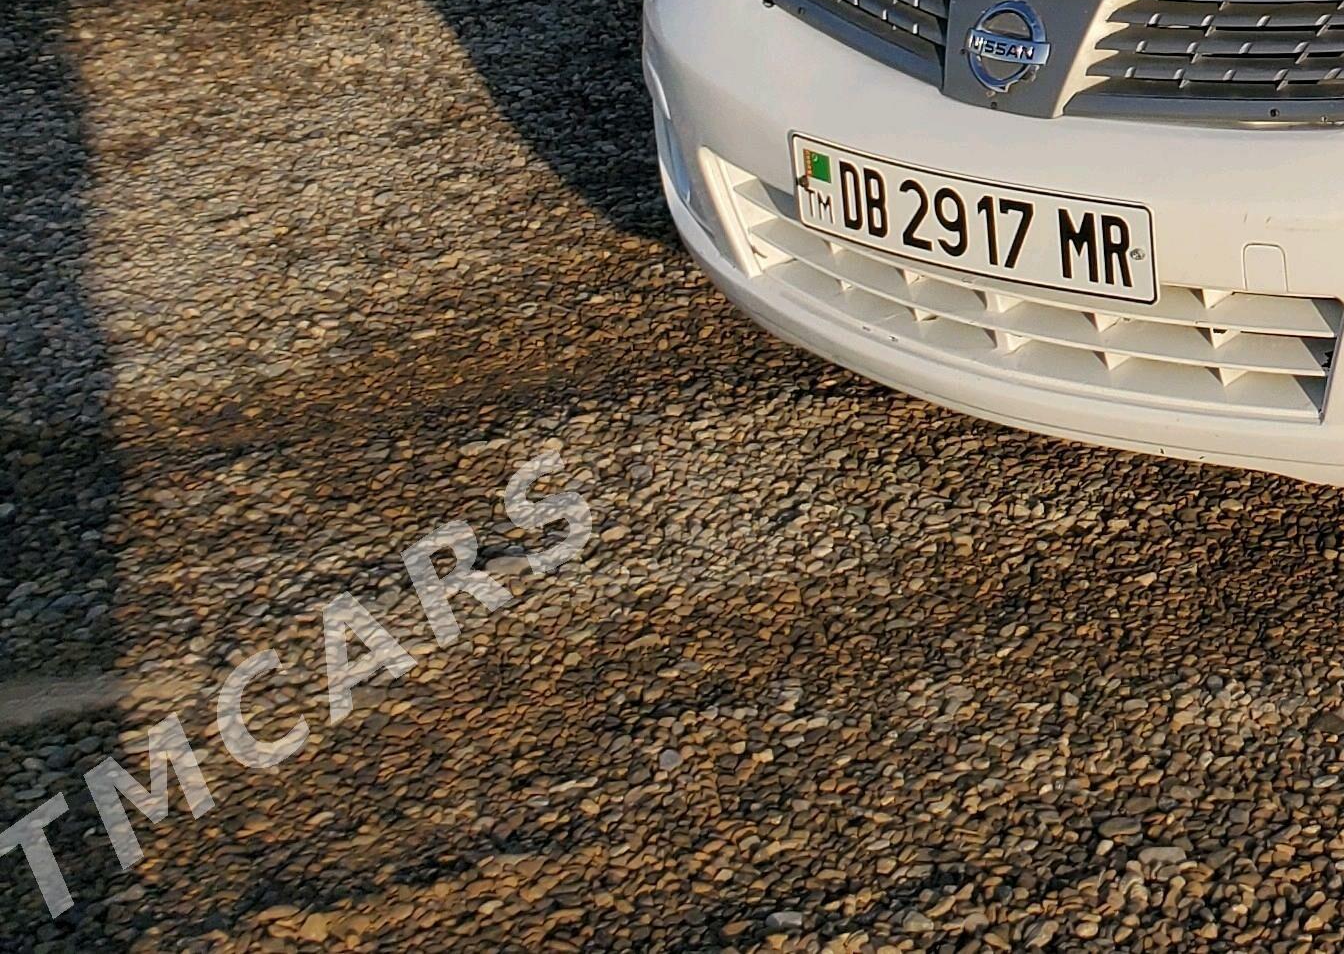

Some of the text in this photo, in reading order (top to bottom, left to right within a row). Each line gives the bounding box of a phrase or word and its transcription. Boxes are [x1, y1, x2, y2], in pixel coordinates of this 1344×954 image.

[969, 34, 1035, 60] NISSAN
[805, 188, 834, 224] TM
[838, 160, 1134, 287] DB 2917 MR
